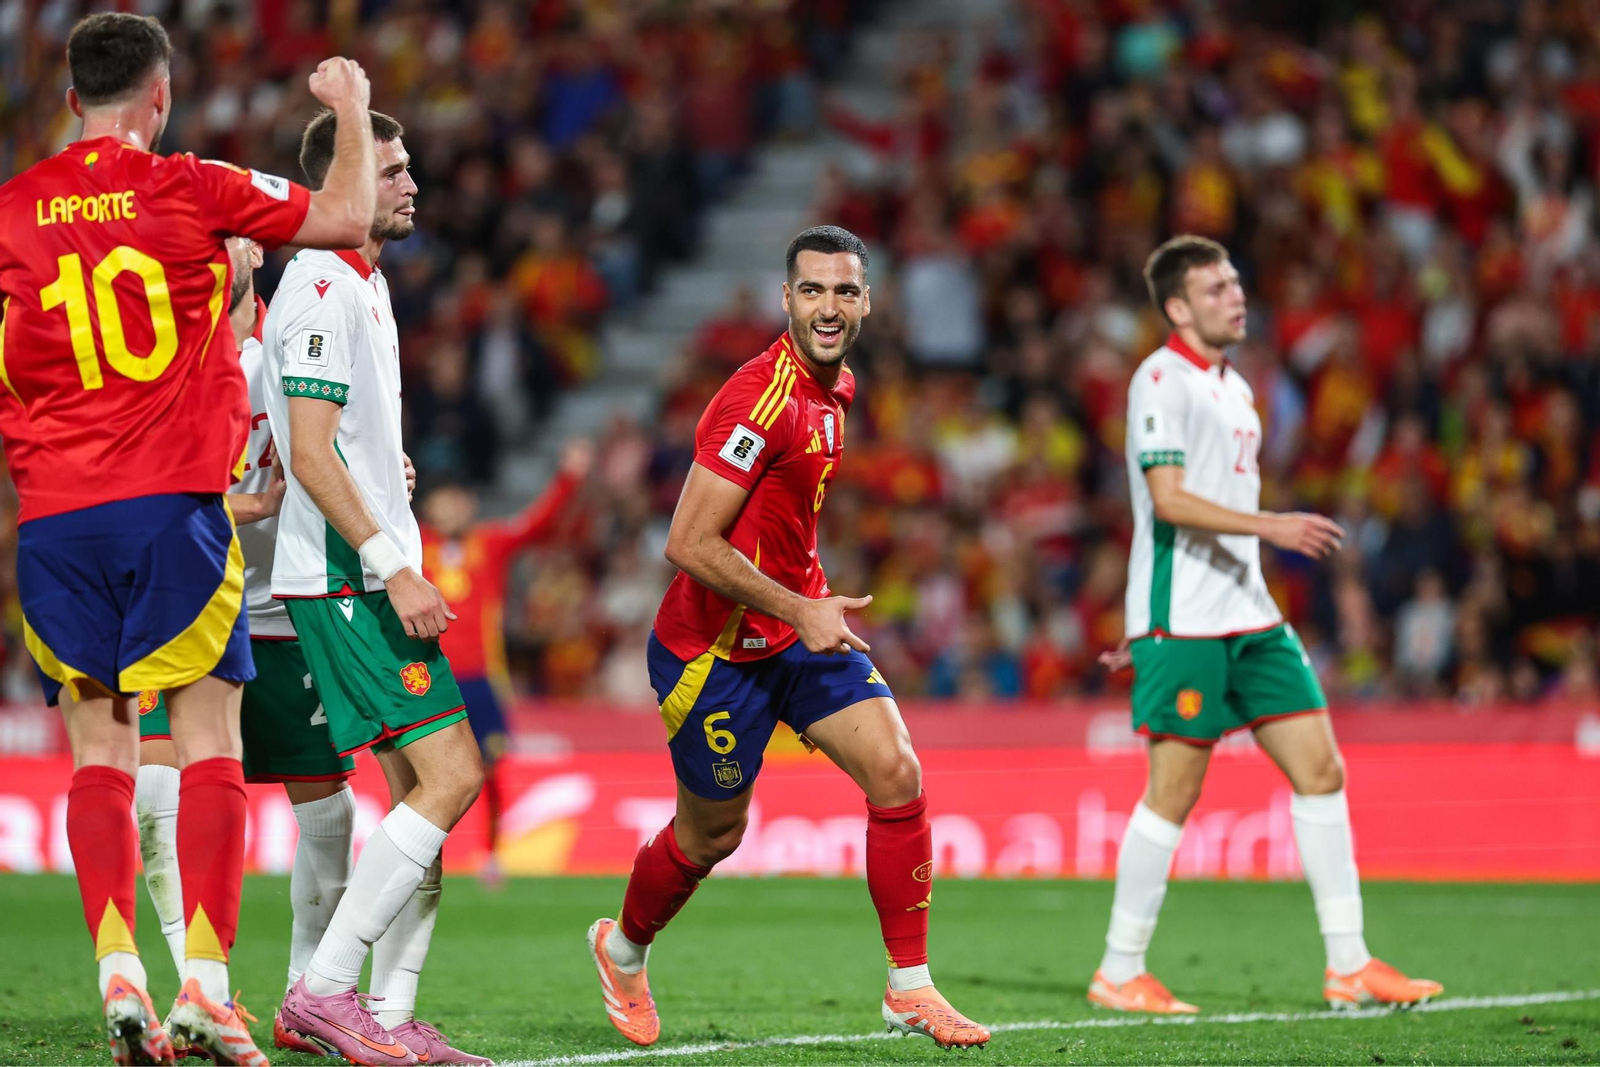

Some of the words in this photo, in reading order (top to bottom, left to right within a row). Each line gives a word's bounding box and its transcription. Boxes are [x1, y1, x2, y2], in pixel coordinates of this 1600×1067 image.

[36, 190, 136, 227] LAPORTE
[39, 245, 179, 390] 10
[813, 462, 833, 513] 6
[703, 711, 737, 755] 6
